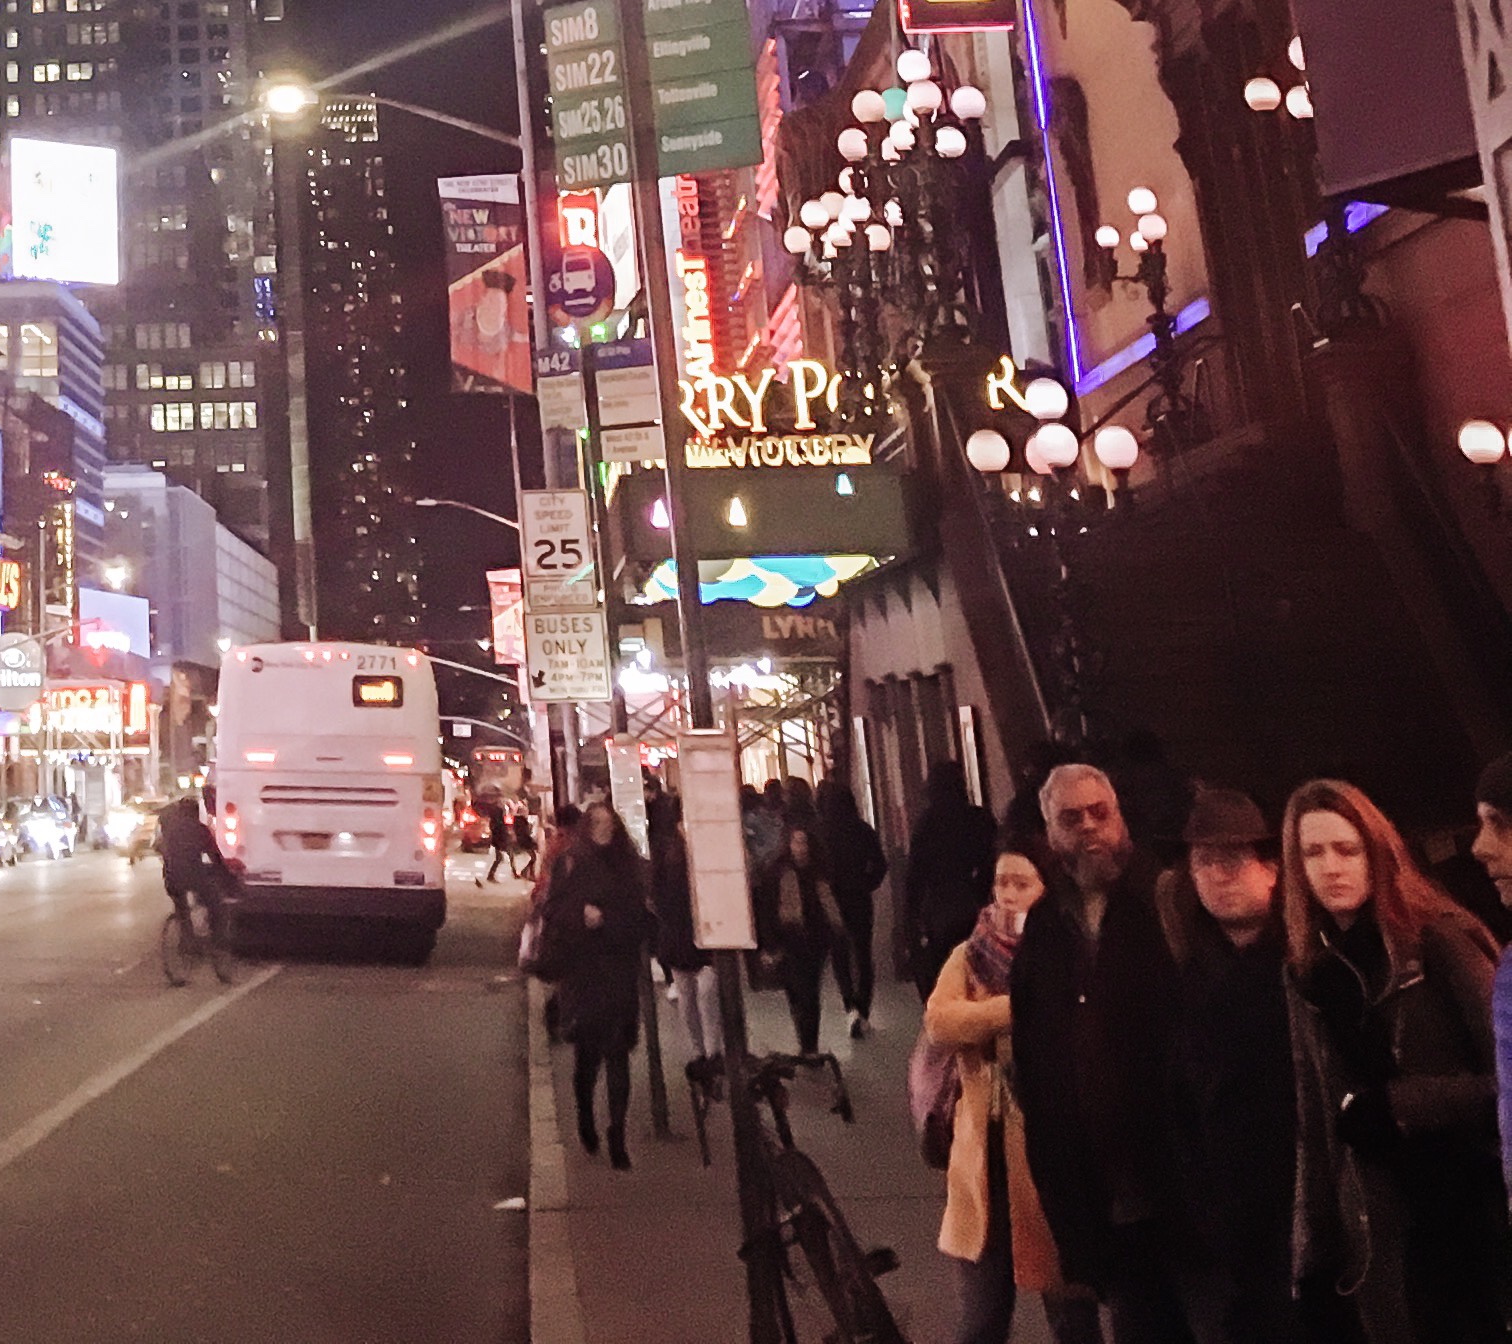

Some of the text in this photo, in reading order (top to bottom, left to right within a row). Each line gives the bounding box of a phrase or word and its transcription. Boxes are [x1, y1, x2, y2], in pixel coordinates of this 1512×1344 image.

[550, 6, 600, 47] SIM8
[554, 49, 618, 92] SIM22
[562, 142, 629, 185] SIM30
[448, 208, 490, 225] NEW
[535, 509, 574, 521] SPEED
[539, 523, 571, 535] LIMIT
[534, 538, 583, 570] 25
[535, 617, 593, 634] BUSES
[541, 639, 588, 656] ONLY
[356, 655, 397, 671] 2771
